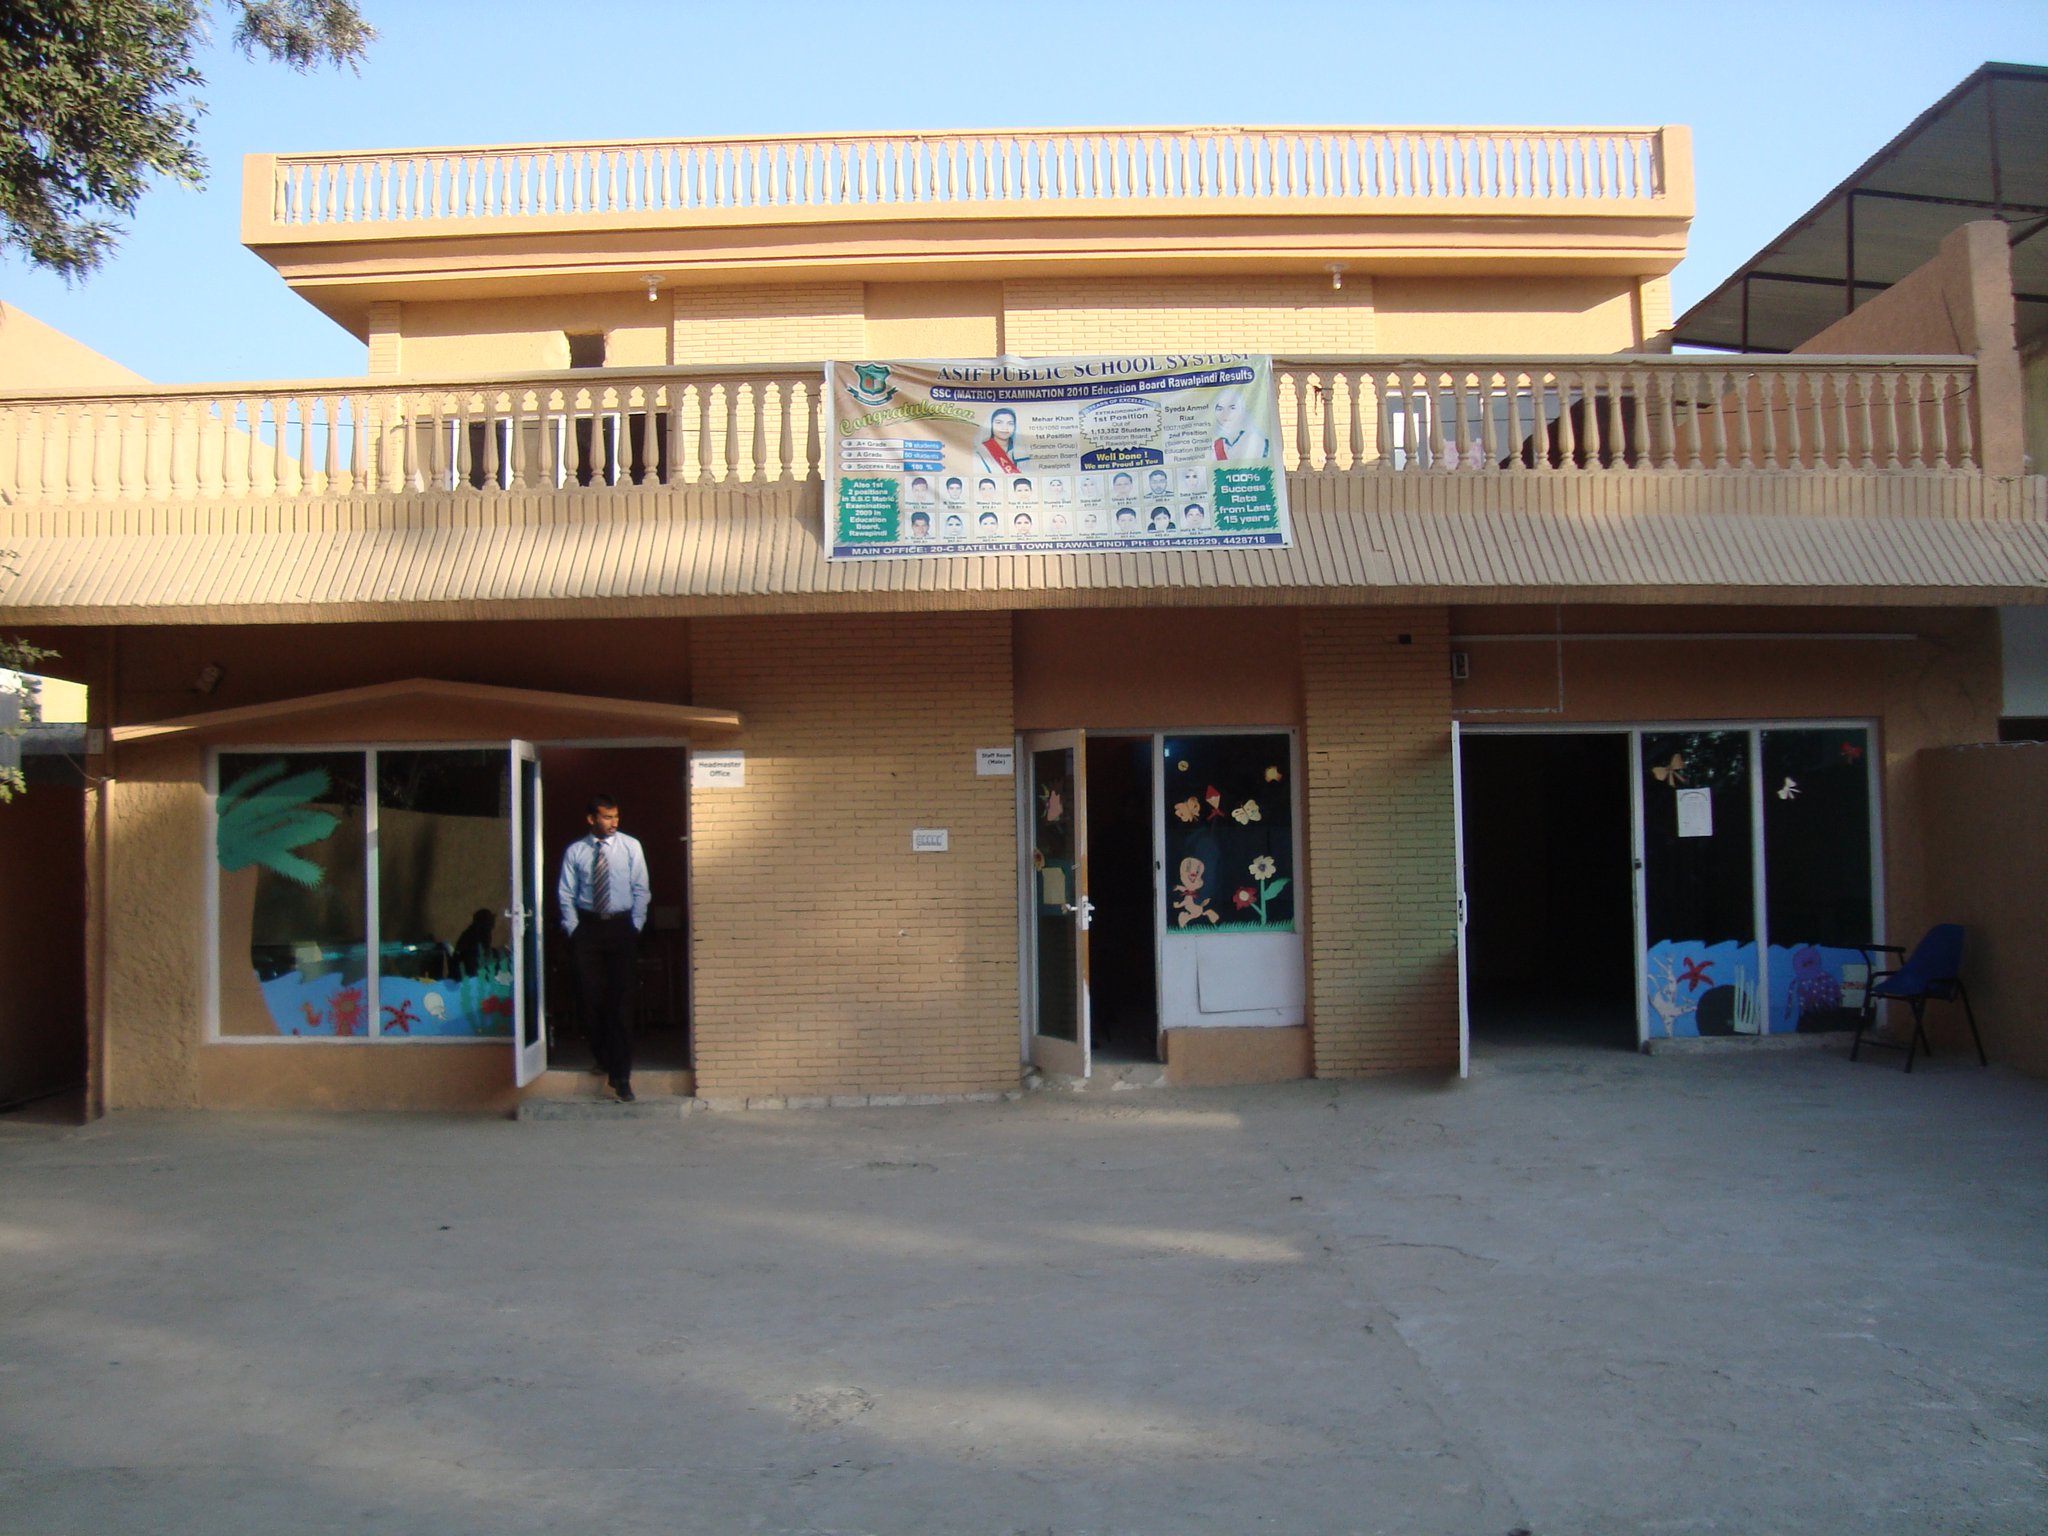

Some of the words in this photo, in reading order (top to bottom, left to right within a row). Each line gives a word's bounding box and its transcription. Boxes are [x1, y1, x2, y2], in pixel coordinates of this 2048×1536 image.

[938, 366, 985, 382] ASIF
[990, 365, 1067, 382] PUBLIC
[1074, 357, 1162, 377] SCHOOL
[932, 388, 951, 398] SSC
[953, 388, 996, 401] (MATRIC)
[999, 387, 1064, 400] EXAMINATION
[1067, 386, 1089, 397] 2010
[1091, 384, 1137, 396] Education
[1139, 379, 1166, 391] Board
[1168, 372, 1218, 387] Rawalpindi
[1220, 369, 1253, 382] Results
[1164, 405, 1186, 413] Syeda
[839, 400, 975, 437] Congratulation
[1109, 413, 1149, 421] Position
[1057, 442, 1079, 450] Group)
[1096, 453, 1116, 461] Well
[1118, 452, 1142, 460] Done
[856, 462, 884, 470] Success
[1111, 460, 1135, 468] Proud
[1225, 473, 1260, 482] 100%
[1220, 485, 1266, 493] Success
[1231, 495, 1257, 503] Rate
[1219, 505, 1245, 513] from
[1246, 504, 1272, 512] Last
[849, 516, 887, 524] Education
[1223, 515, 1238, 523] 15
[1239, 514, 1270, 524] years
[852, 547, 880, 555] MAIN
[883, 546, 927, 554] OFFICE:
[957, 543, 1016, 552] SATELLITE
[1019, 542, 1053, 550] TOWN
[1056, 540, 1129, 549] RAWALPINDI,
[1223, 536, 1266, 544] 4428718
